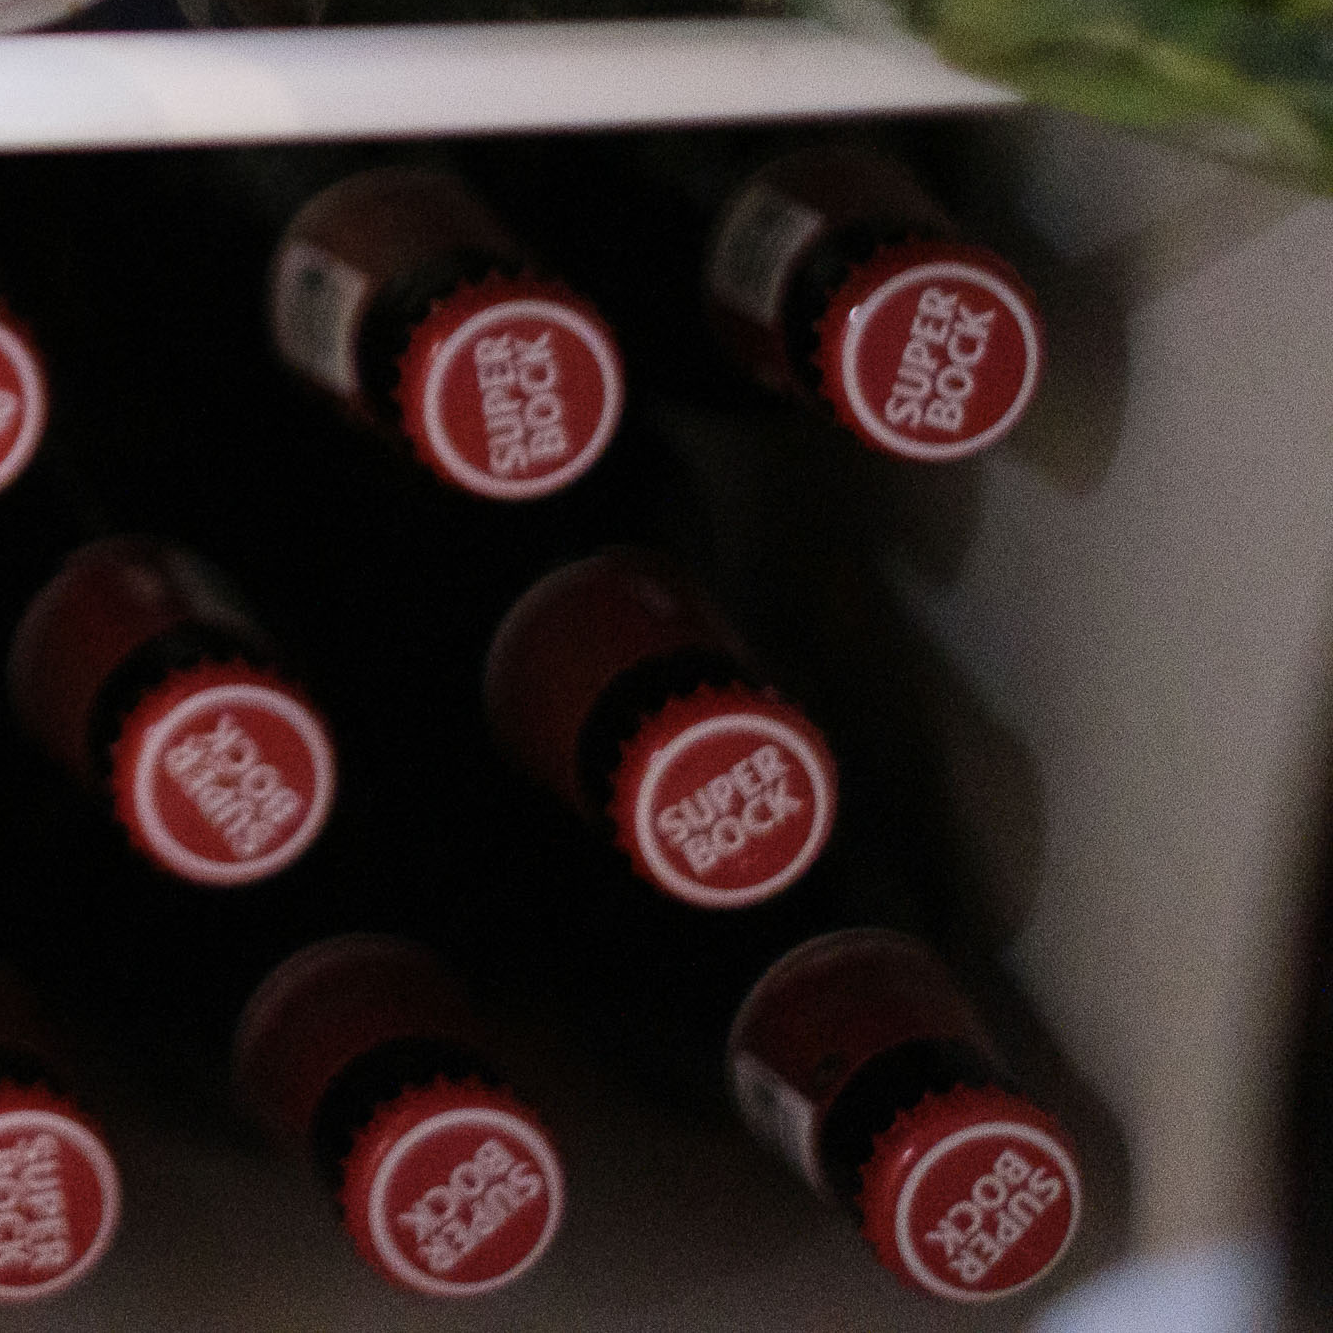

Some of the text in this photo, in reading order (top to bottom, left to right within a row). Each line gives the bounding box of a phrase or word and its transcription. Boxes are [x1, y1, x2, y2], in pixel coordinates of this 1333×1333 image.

[474, 334, 531, 472] SUPER
[512, 332, 568, 462] BOCK
[885, 288, 958, 428] SUPER
[921, 305, 995, 432] BOCK
[160, 738, 277, 855] SUPER
[188, 716, 300, 827] BOCK
[657, 745, 788, 846] SUPER
[679, 776, 801, 874] BOCK
[13, 1134, 69, 1268] SUPER
[399, 1139, 518, 1242] BOCK
[419, 1163, 539, 1272] SUPER
[926, 1149, 1037, 1257] BOCK
[950, 1168, 1059, 1281] SUPER
